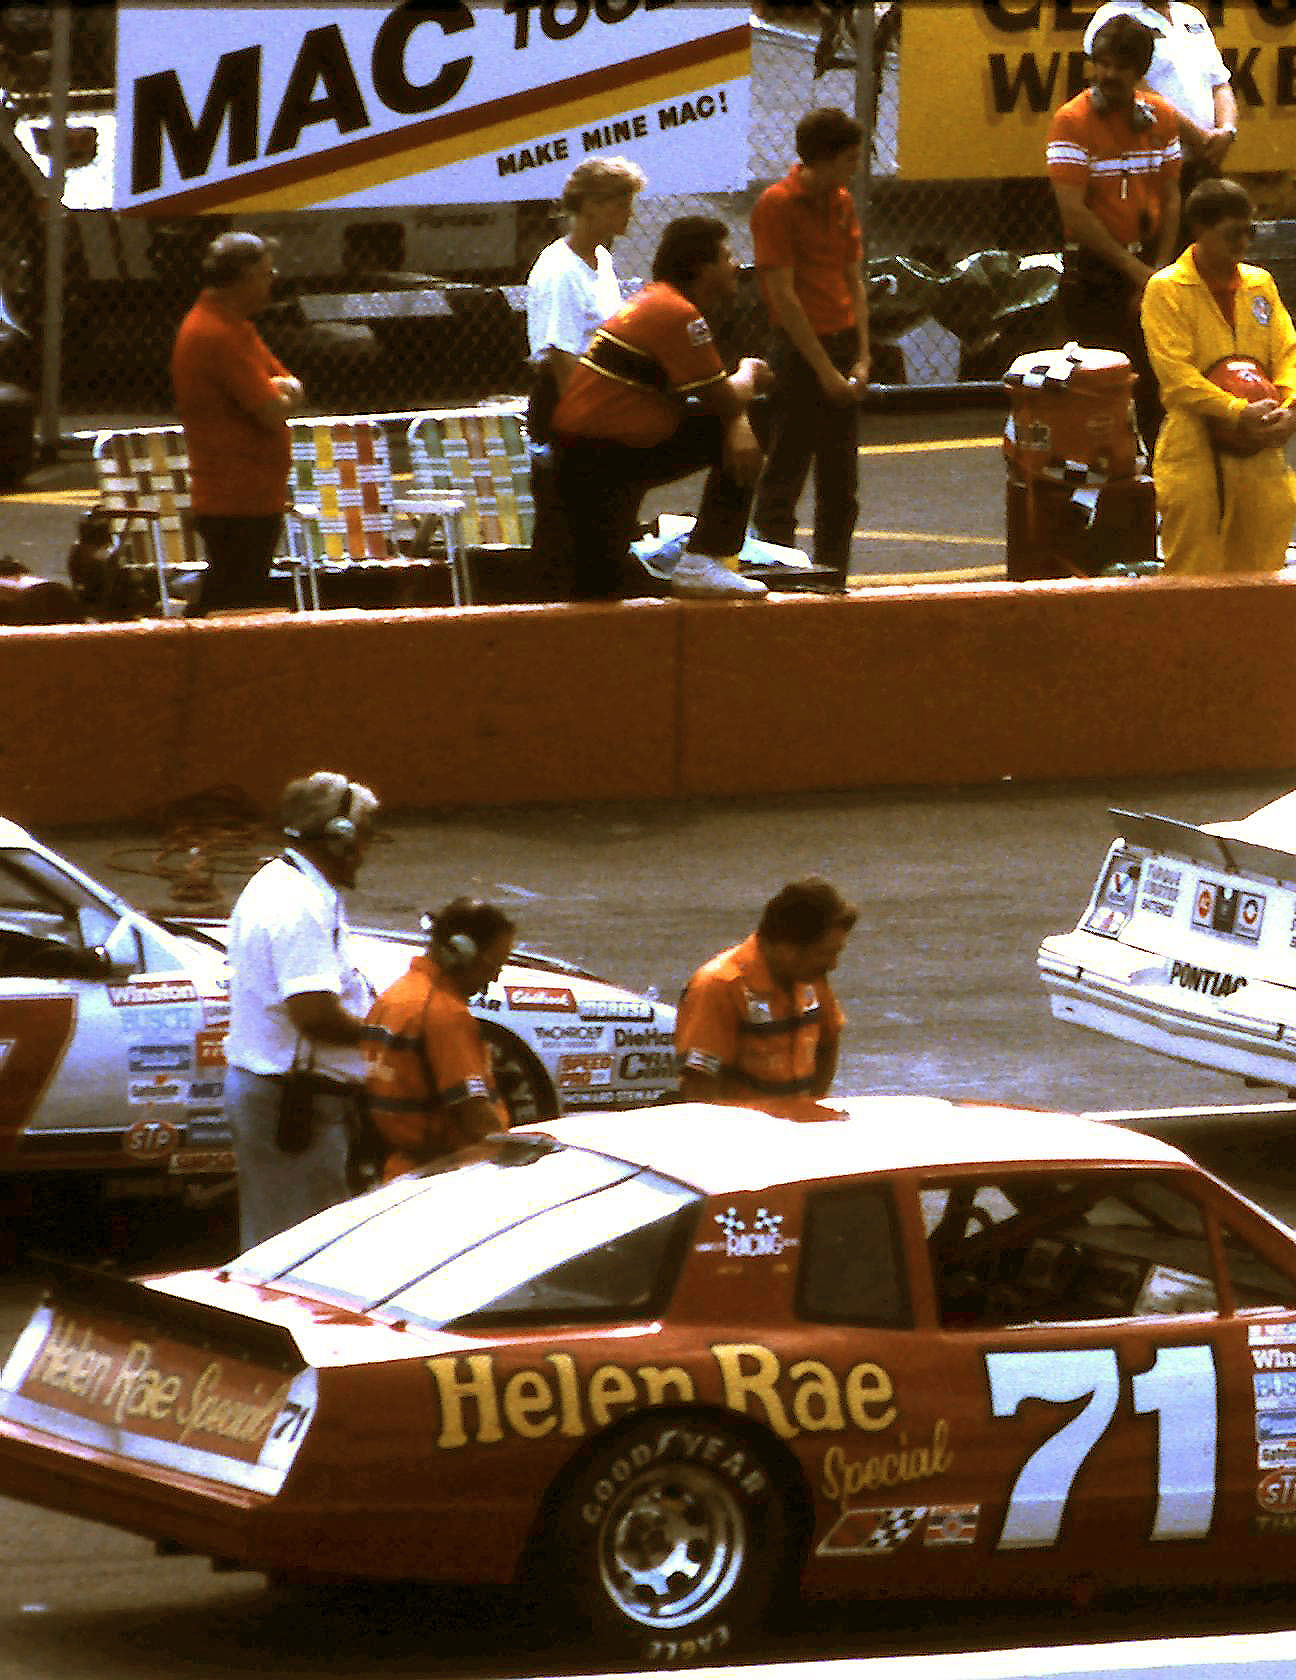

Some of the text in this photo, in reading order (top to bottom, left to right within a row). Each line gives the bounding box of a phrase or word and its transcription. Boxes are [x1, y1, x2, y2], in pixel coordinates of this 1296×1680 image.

[131, 0, 474, 195] MAC
[496, 91, 728, 176] MAKE MINE MAC!
[274, 1401, 310, 1442] 71
[424, 1343, 898, 1449] Helen Rae
[821, 1418, 956, 1513] Special
[984, 1344, 1218, 1551] 71
